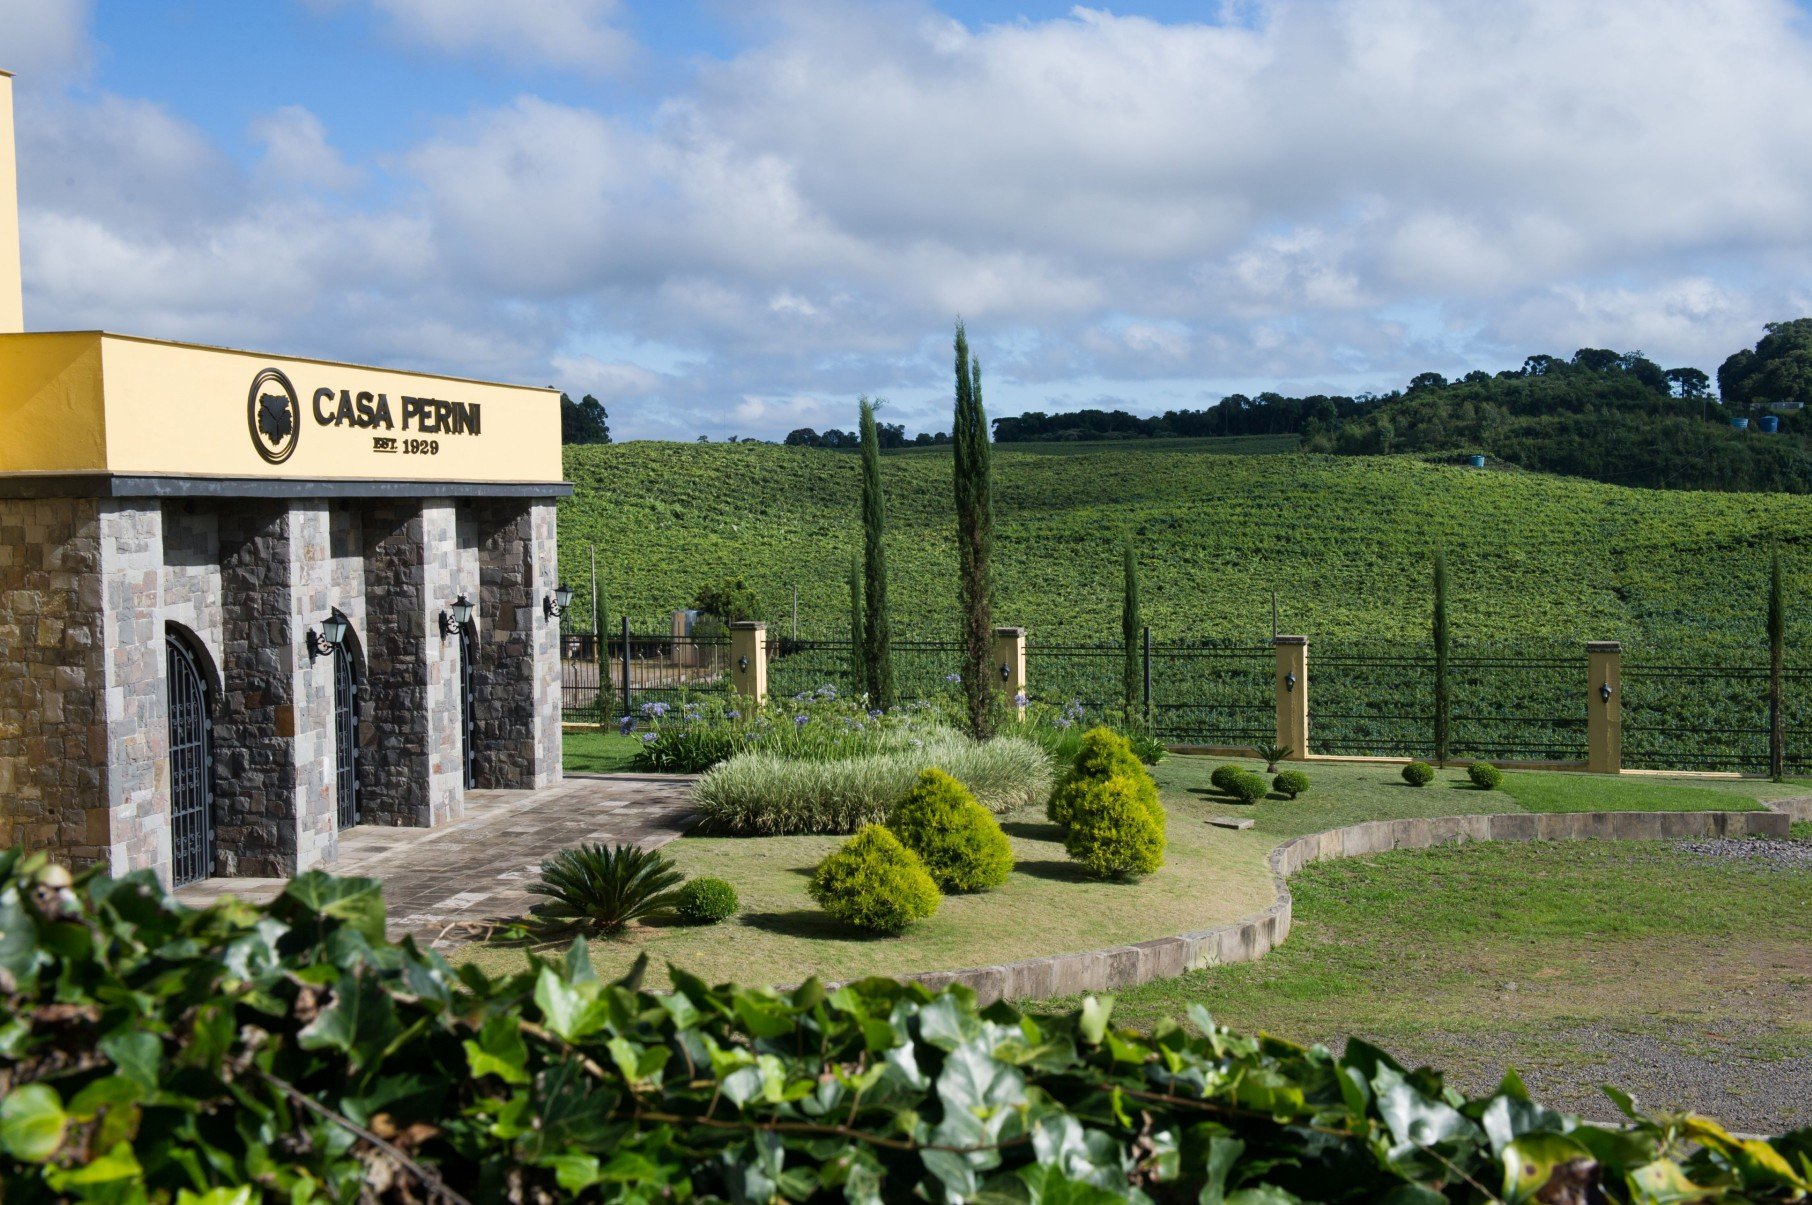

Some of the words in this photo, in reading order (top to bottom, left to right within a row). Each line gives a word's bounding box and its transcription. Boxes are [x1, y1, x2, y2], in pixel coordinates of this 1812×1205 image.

[313, 387, 395, 430] CASA
[401, 395, 481, 436] PERINI
[373, 437, 398, 450] EST.
[403, 439, 439, 455] 1929
